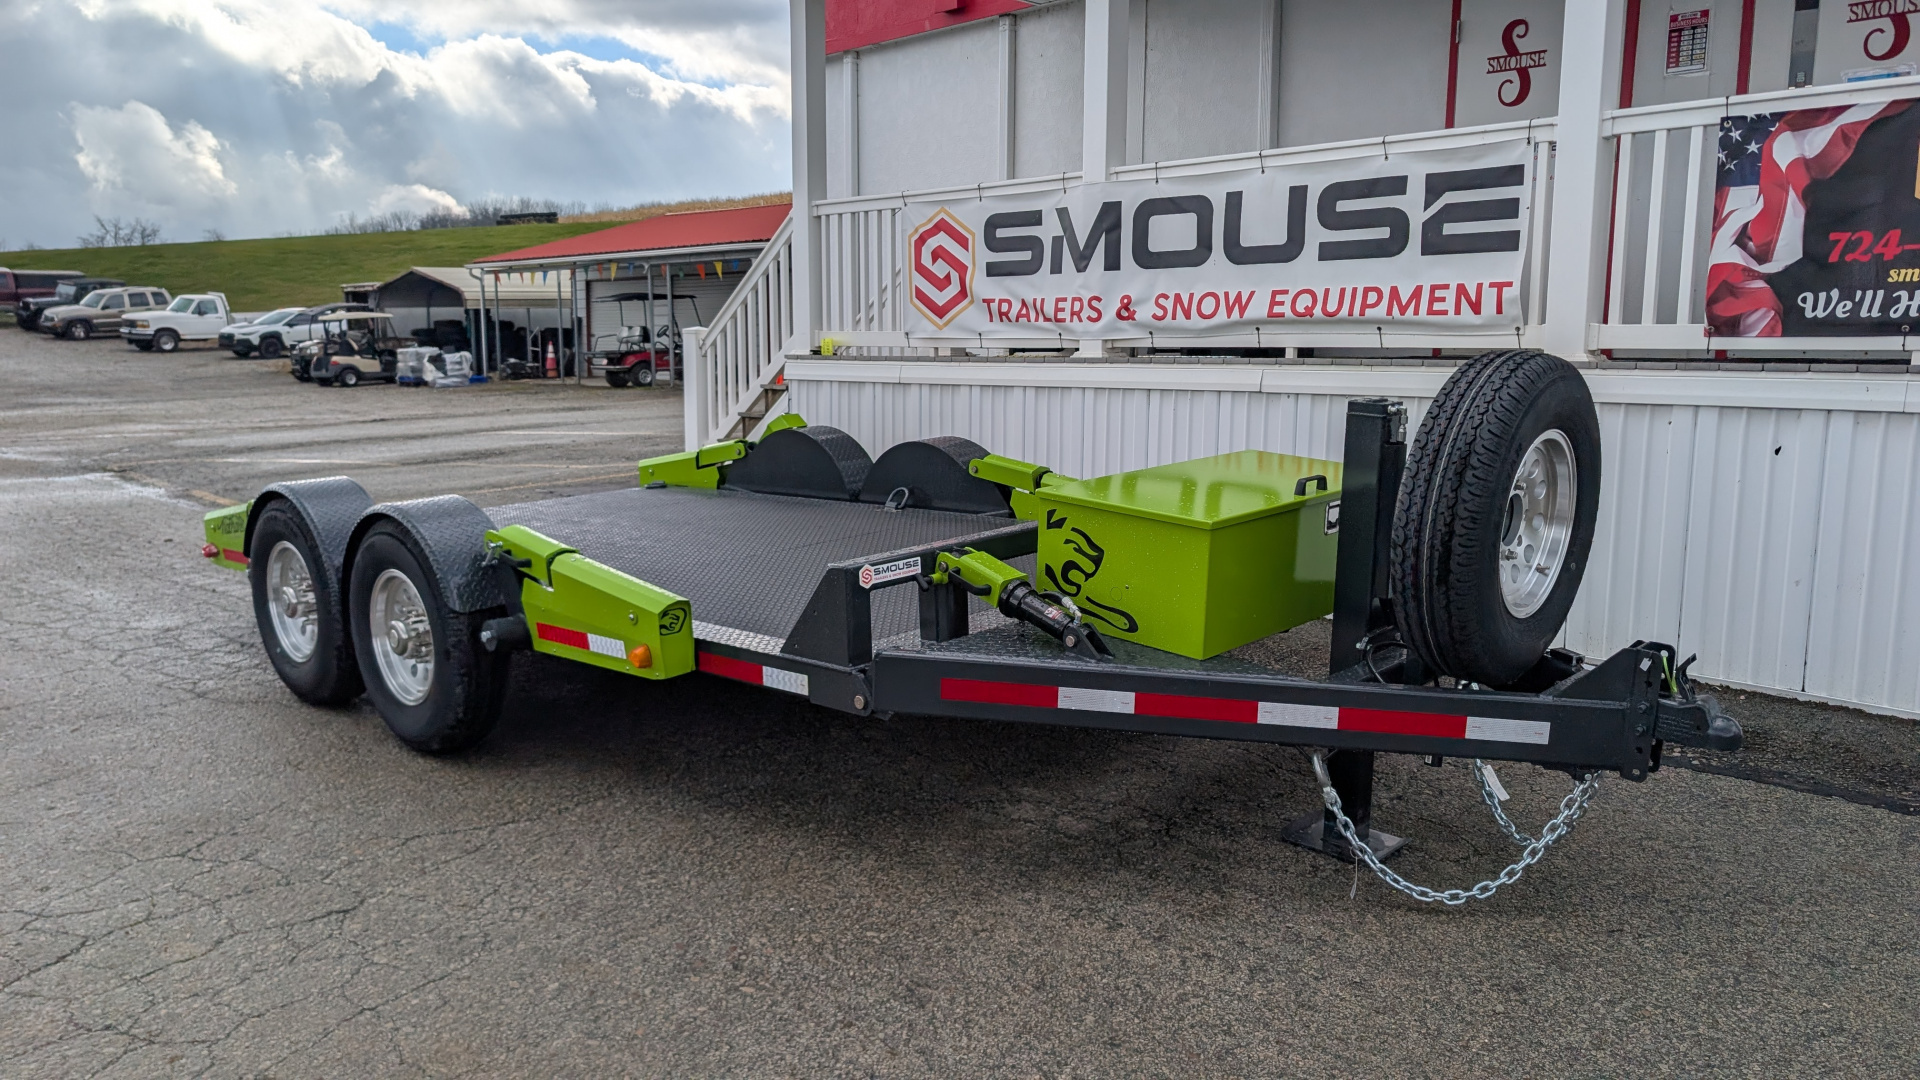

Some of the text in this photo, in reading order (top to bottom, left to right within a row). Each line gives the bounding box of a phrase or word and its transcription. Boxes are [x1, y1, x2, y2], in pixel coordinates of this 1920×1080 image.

[1487, 51, 1547, 73] SMOUSE
[983, 163, 1525, 278] SMOUSE
[1887, 268, 1920, 283] sm
[981, 281, 1514, 324] TRAILERS & SNOW EQUIPMENT
[1797, 288, 1885, 318] We'll
[873, 559, 919, 575] SMOUSE
